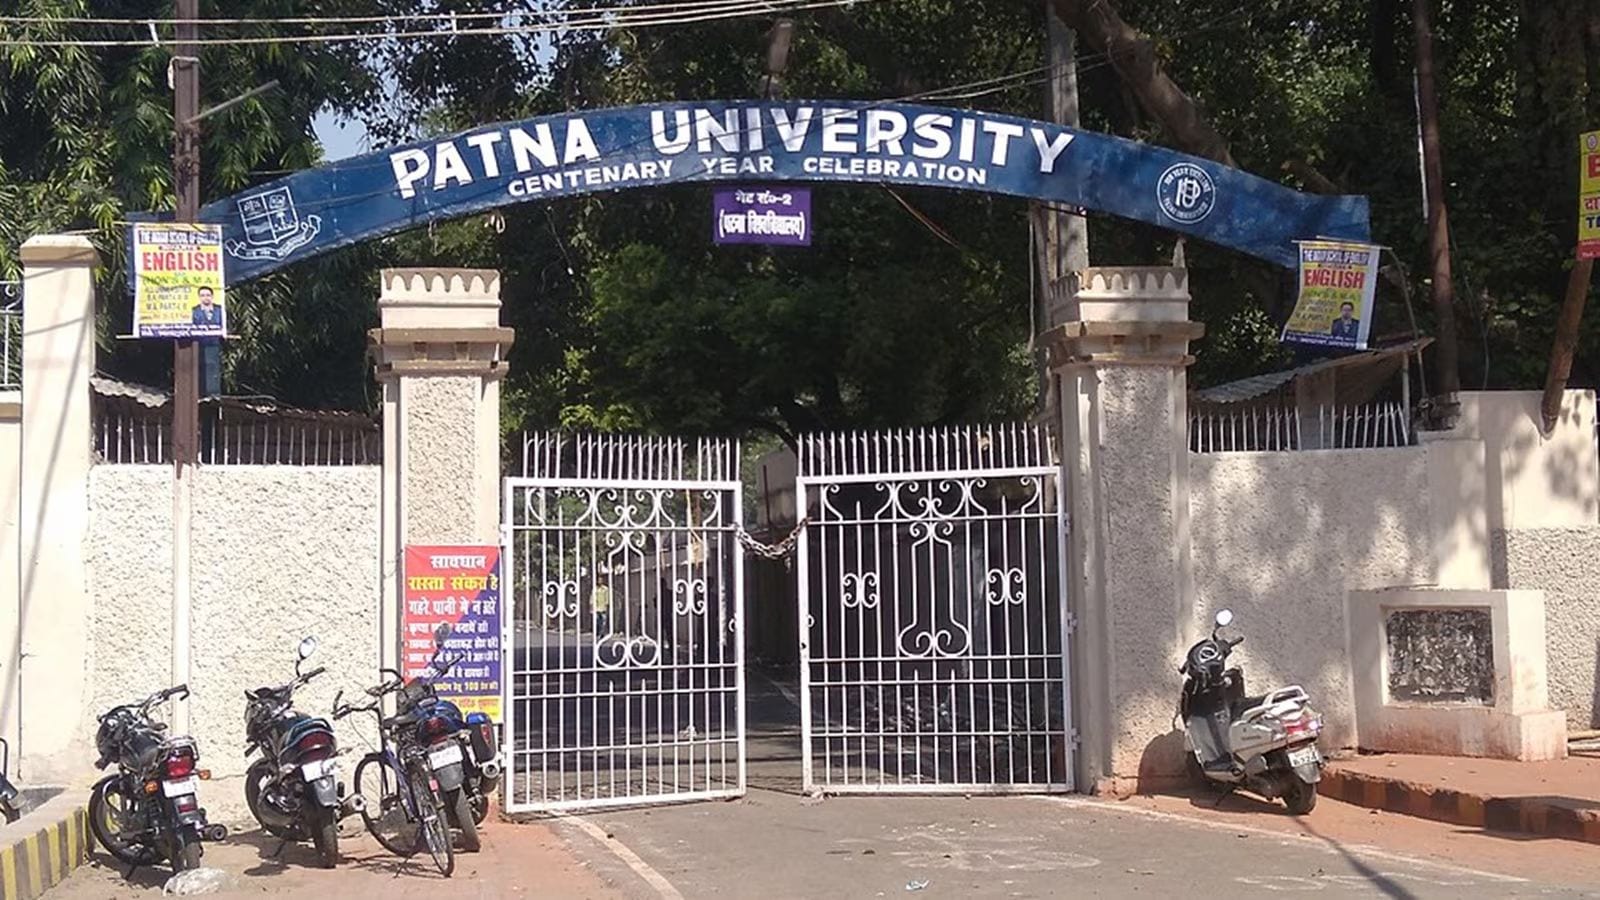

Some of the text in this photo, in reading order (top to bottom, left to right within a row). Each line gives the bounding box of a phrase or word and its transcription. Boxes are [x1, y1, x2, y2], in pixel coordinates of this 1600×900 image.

[390, 107, 1075, 199] PATNA UNIVERSITY
[508, 156, 987, 196] CENTENARY YEAR CELEBRATION
[735, 189, 754, 203] गेट
[142, 252, 219, 272] ENGLISH
[1304, 269, 1366, 289] ENGLISH
[430, 555, 486, 569] सावधान
[408, 576, 446, 590] रास्ता
[432, 596, 456, 615] पानी
